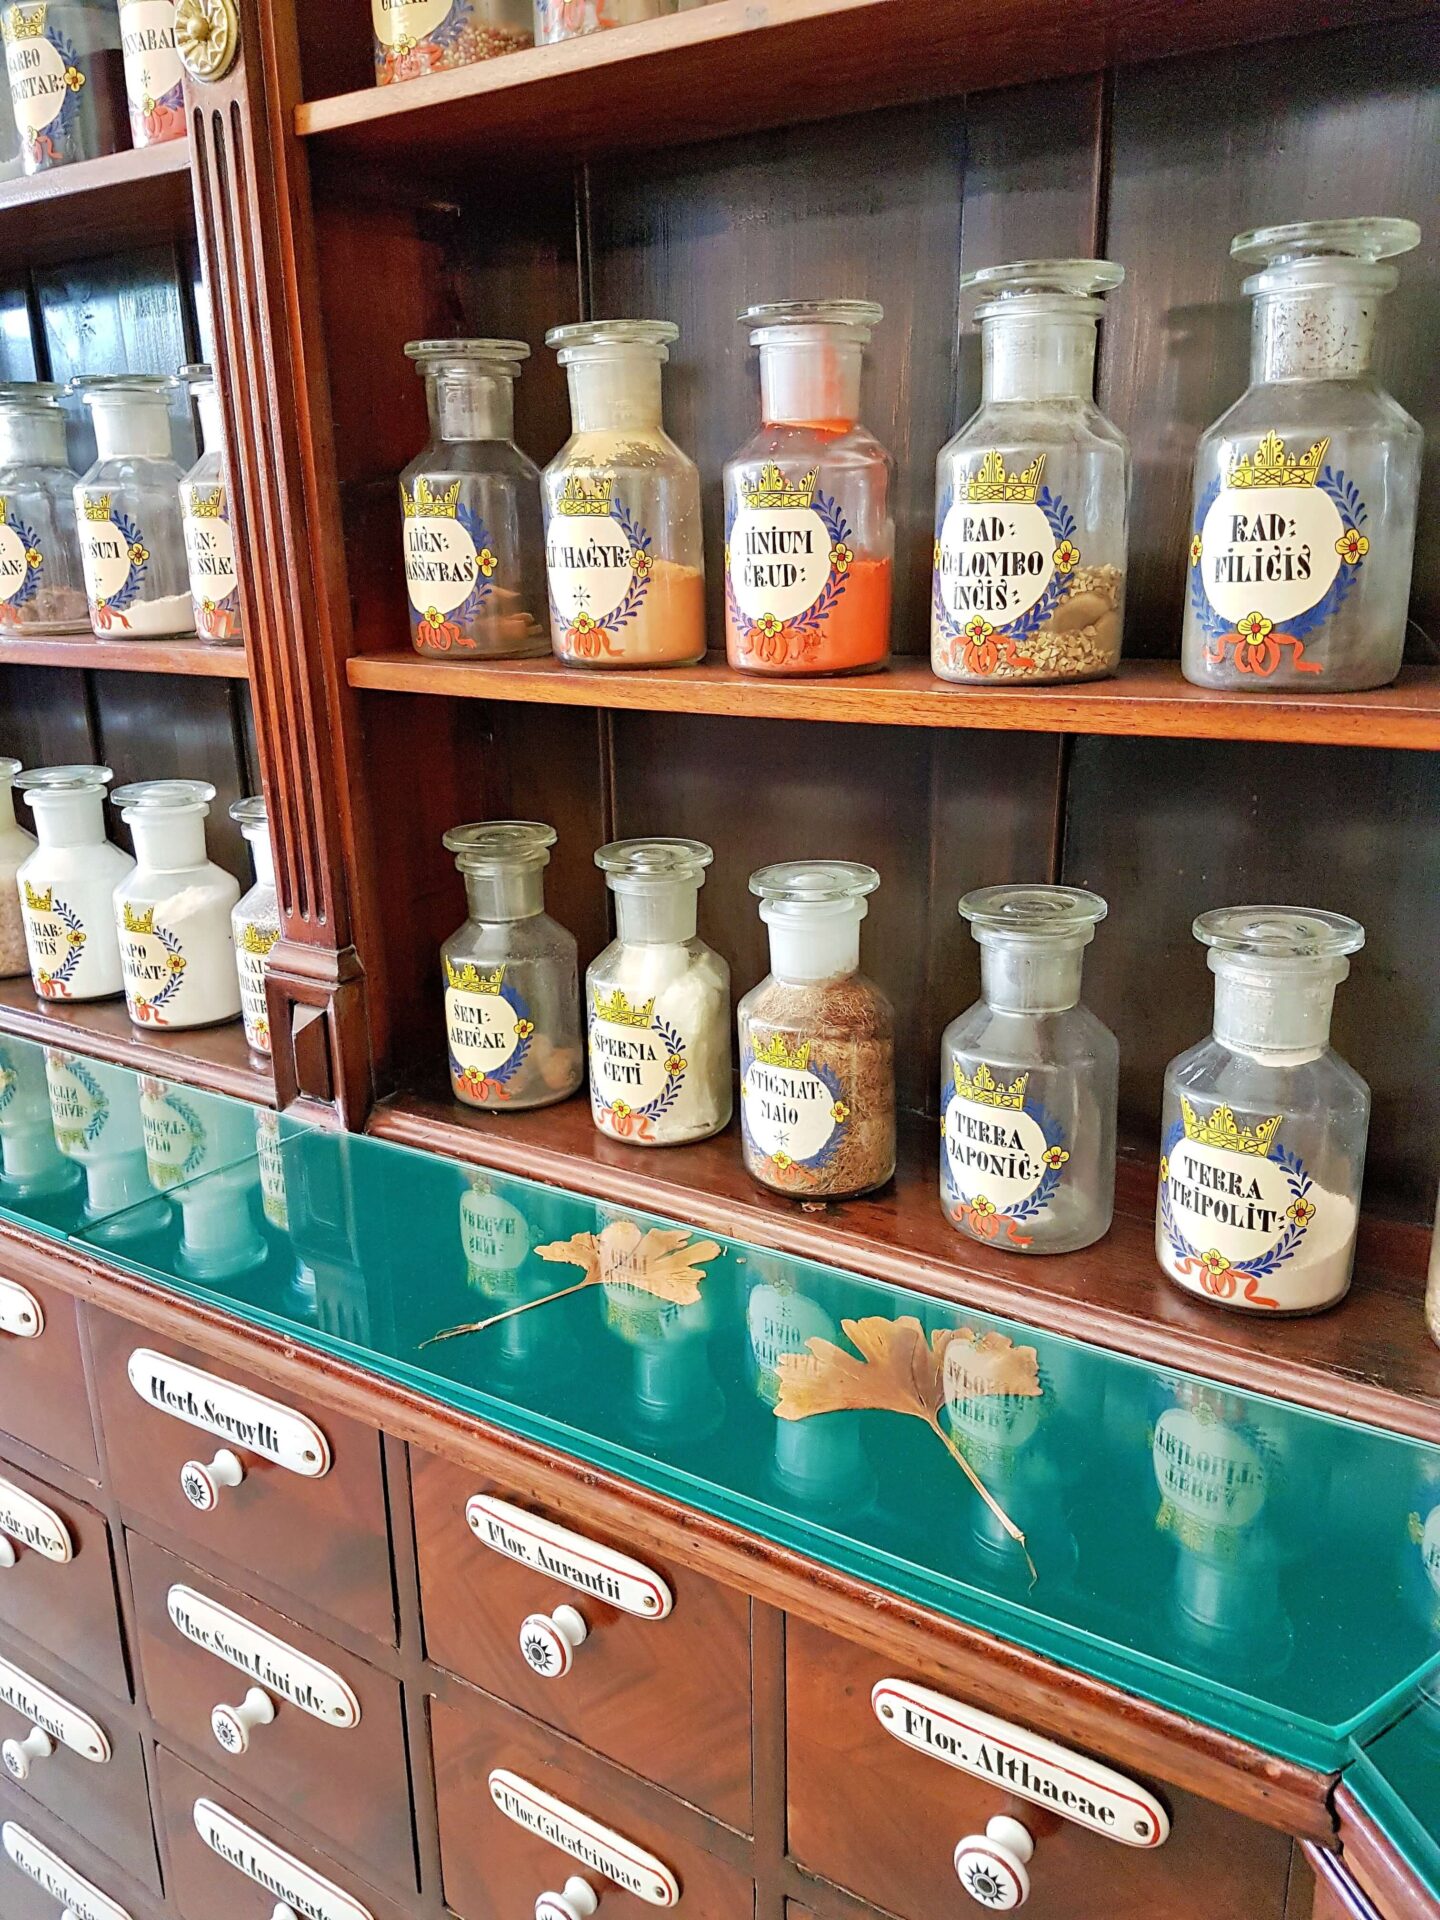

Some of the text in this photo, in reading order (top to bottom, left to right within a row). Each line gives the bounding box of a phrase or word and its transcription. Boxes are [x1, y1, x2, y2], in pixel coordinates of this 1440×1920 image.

[409, 526, 450, 552] LIGN:
[963, 517, 1018, 542] RAD:
[1229, 513, 1296, 543] RAD:
[744, 558, 806, 587] CRUD:
[1213, 544, 1311, 583] FILICIS
[954, 579, 1020, 611] INCIS:
[453, 999, 491, 1024] SEM:
[595, 1028, 658, 1061] SPERMA
[604, 1057, 643, 1085] CETI
[761, 1100, 798, 1125] MAIO
[955, 1111, 1025, 1151] TERRA
[950, 1135, 1040, 1181] JAPONIC:
[1184, 1156, 1264, 1201] TERRA
[1171, 1177, 1286, 1233] TRIPOLIT:
[486, 1518, 621, 1600] Flor. Aurantii
[902, 1705, 1116, 1827] Flor. Althaeae
